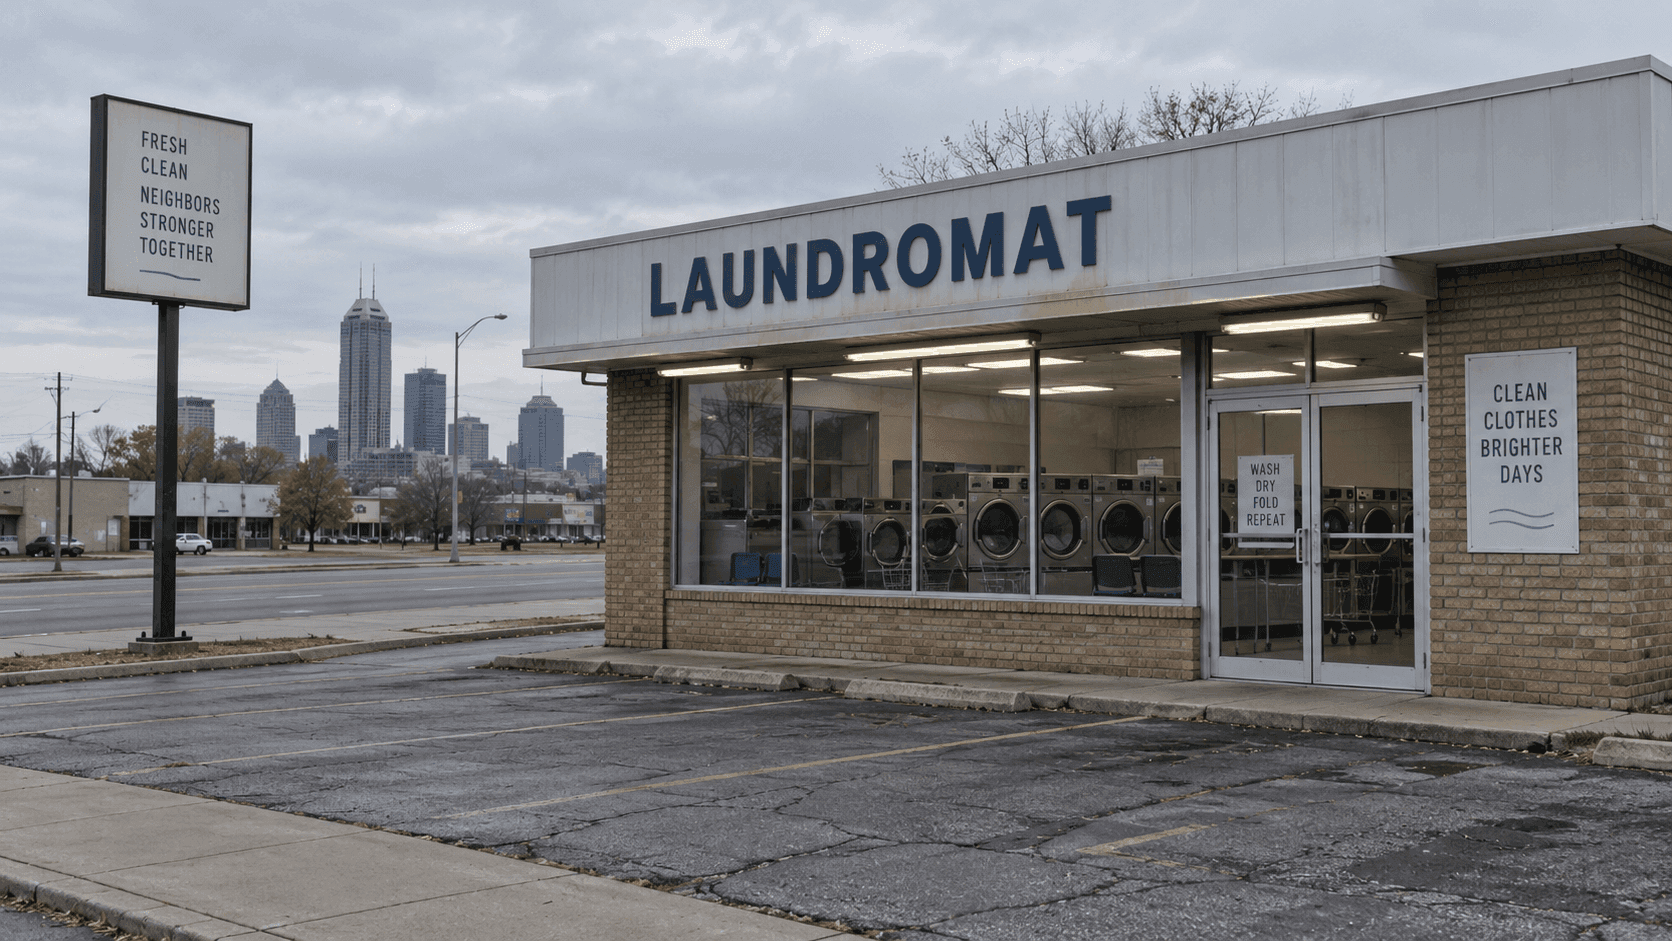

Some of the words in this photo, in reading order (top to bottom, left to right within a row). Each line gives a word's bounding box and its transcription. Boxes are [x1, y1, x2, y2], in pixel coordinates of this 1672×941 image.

[141, 130, 187, 155] FRESH
[141, 156, 188, 180] CLEAN
[140, 185, 220, 215] NEIGHBORS
[140, 211, 214, 239] STRONGER
[139, 236, 213, 263] TOGETHER
[650, 194, 1112, 317] LAUNDROMAT
[1493, 382, 1547, 403] CLEAN
[1484, 409, 1558, 430] CLOTHES
[1481, 436, 1563, 458] BRIGHTER
[1250, 462, 1280, 476] WASH
[1500, 464, 1543, 484] DAYS
[1255, 479, 1276, 492] DRY
[1253, 496, 1279, 509] FOLD
[1247, 513, 1286, 526] REPEAT
